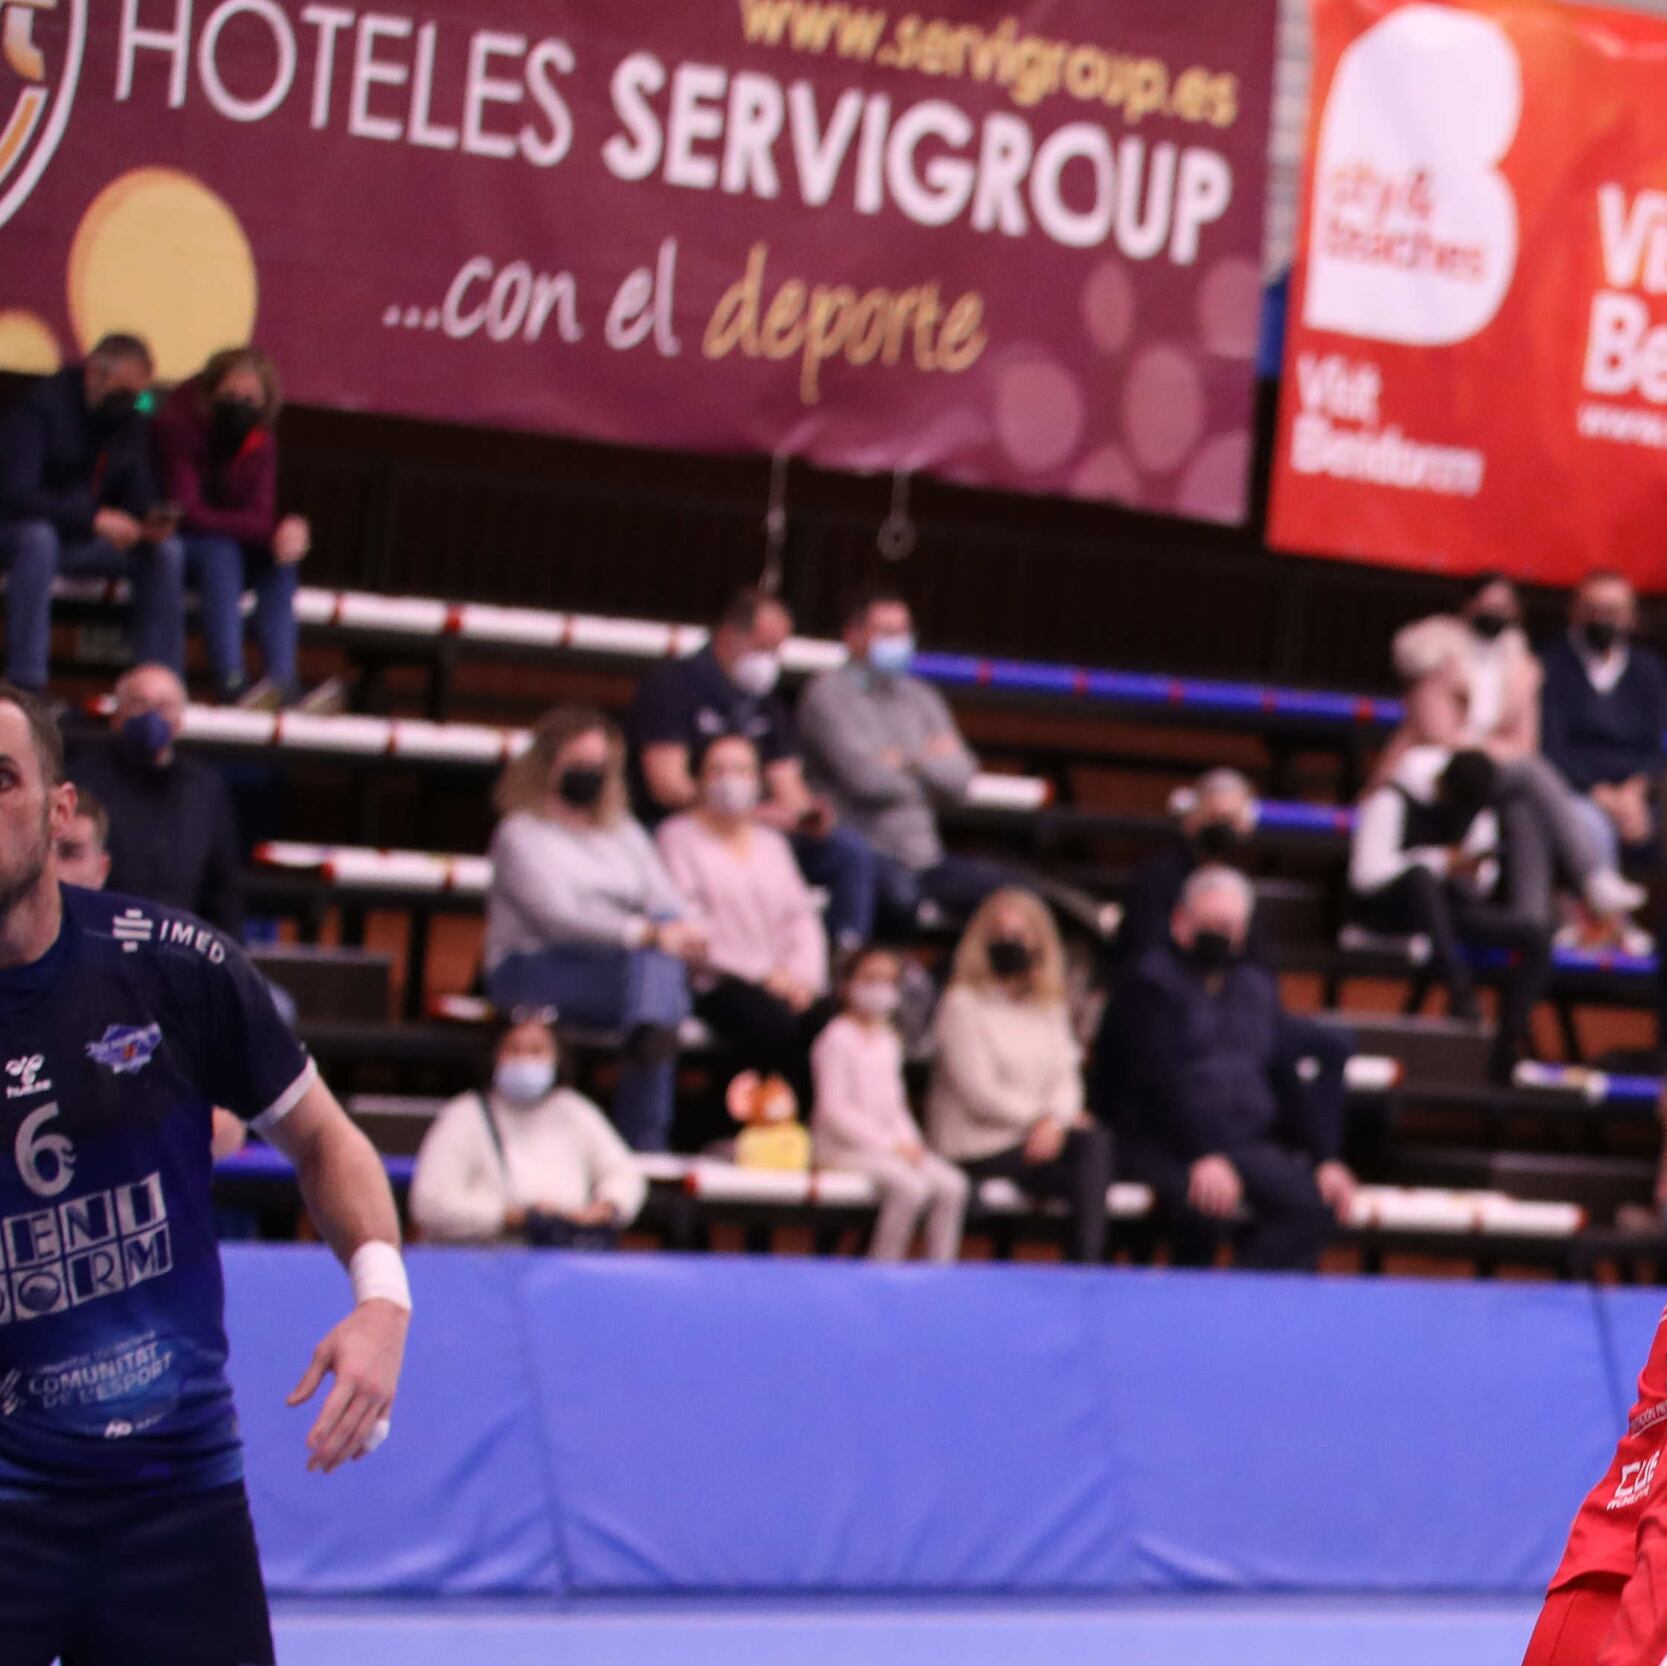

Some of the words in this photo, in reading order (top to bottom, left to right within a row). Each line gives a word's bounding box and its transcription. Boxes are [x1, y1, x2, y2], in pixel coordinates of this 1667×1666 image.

[739, 0, 1238, 127] www.servigroup.es
[115, 0, 576, 167] HOTELES
[602, 51, 1233, 266] SERVIGROUP
[604, 237, 681, 357] el
[703, 242, 988, 405] deporte
[1290, 413, 1486, 499] Benidorm
[159, 919, 226, 965] IMED
[15, 1101, 76, 1197] 6
[2, 1172, 168, 1272] ENI
